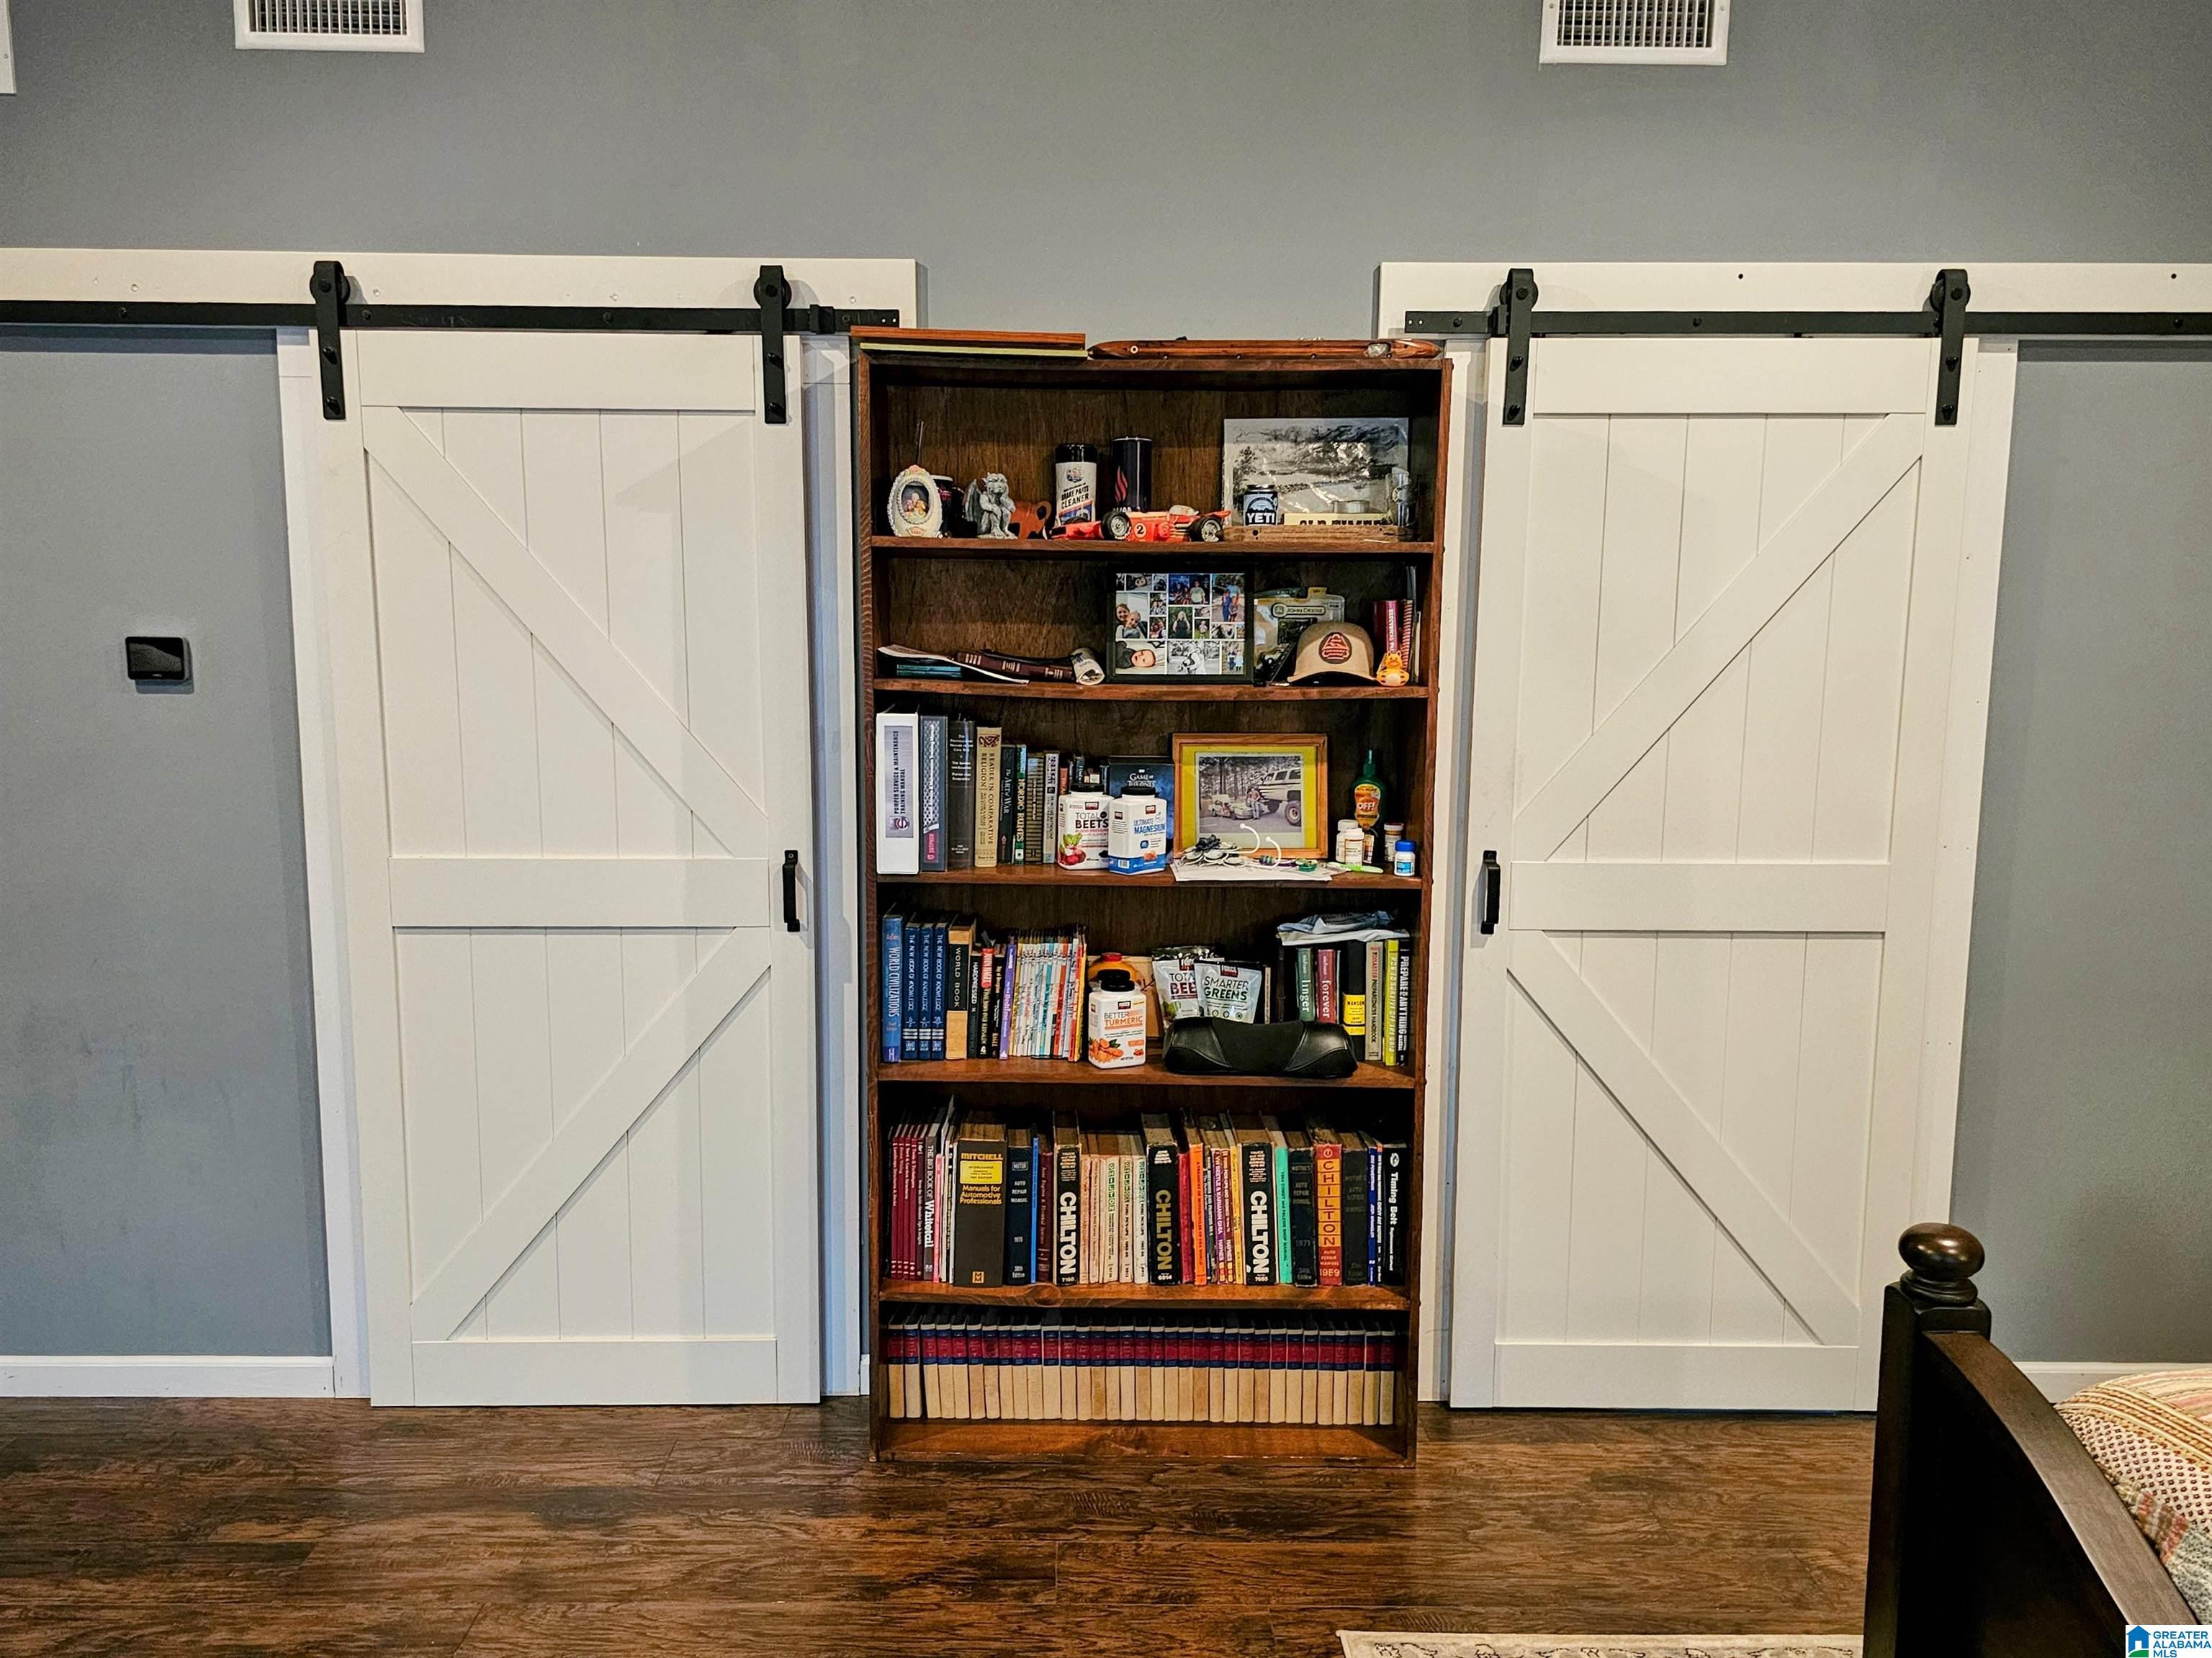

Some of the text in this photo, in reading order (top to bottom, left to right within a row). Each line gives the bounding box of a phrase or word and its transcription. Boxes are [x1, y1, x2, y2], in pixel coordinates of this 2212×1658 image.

[1061, 493, 1089, 510] CLEANER
[1246, 513, 1275, 523] YETI
[1136, 525, 1144, 534] 2
[1076, 819, 1109, 828] BEETS
[1134, 824, 1165, 834] MAGNESIUM
[889, 947, 900, 971] WORLD
[984, 952, 992, 966] JOHN
[1169, 973, 1195, 982] TOTA
[1204, 976, 1249, 991] SMARTER
[889, 973, 900, 1017] CIVILIZATIONS
[1170, 982, 1197, 995] BEE
[1204, 987, 1247, 1001] GREENS
[1299, 980, 1311, 1012] linger
[1398, 956, 1409, 1034] PREPARE ANYTHING
[1322, 979, 1331, 1018] forever
[1105, 1016, 1143, 1026] TURMERIC
[926, 1189, 933, 1199] OF
[1389, 1172, 1398, 1204] Timing
[1323, 1161, 1336, 1245] CHILTON
[925, 1199, 935, 1248] Whitetail
[1390, 1206, 1398, 1225] Belt
[1060, 1191, 1076, 1274] CHILTON
[1155, 1189, 1172, 1270] CHILTON
[1250, 1191, 1269, 1274] CHILTON
